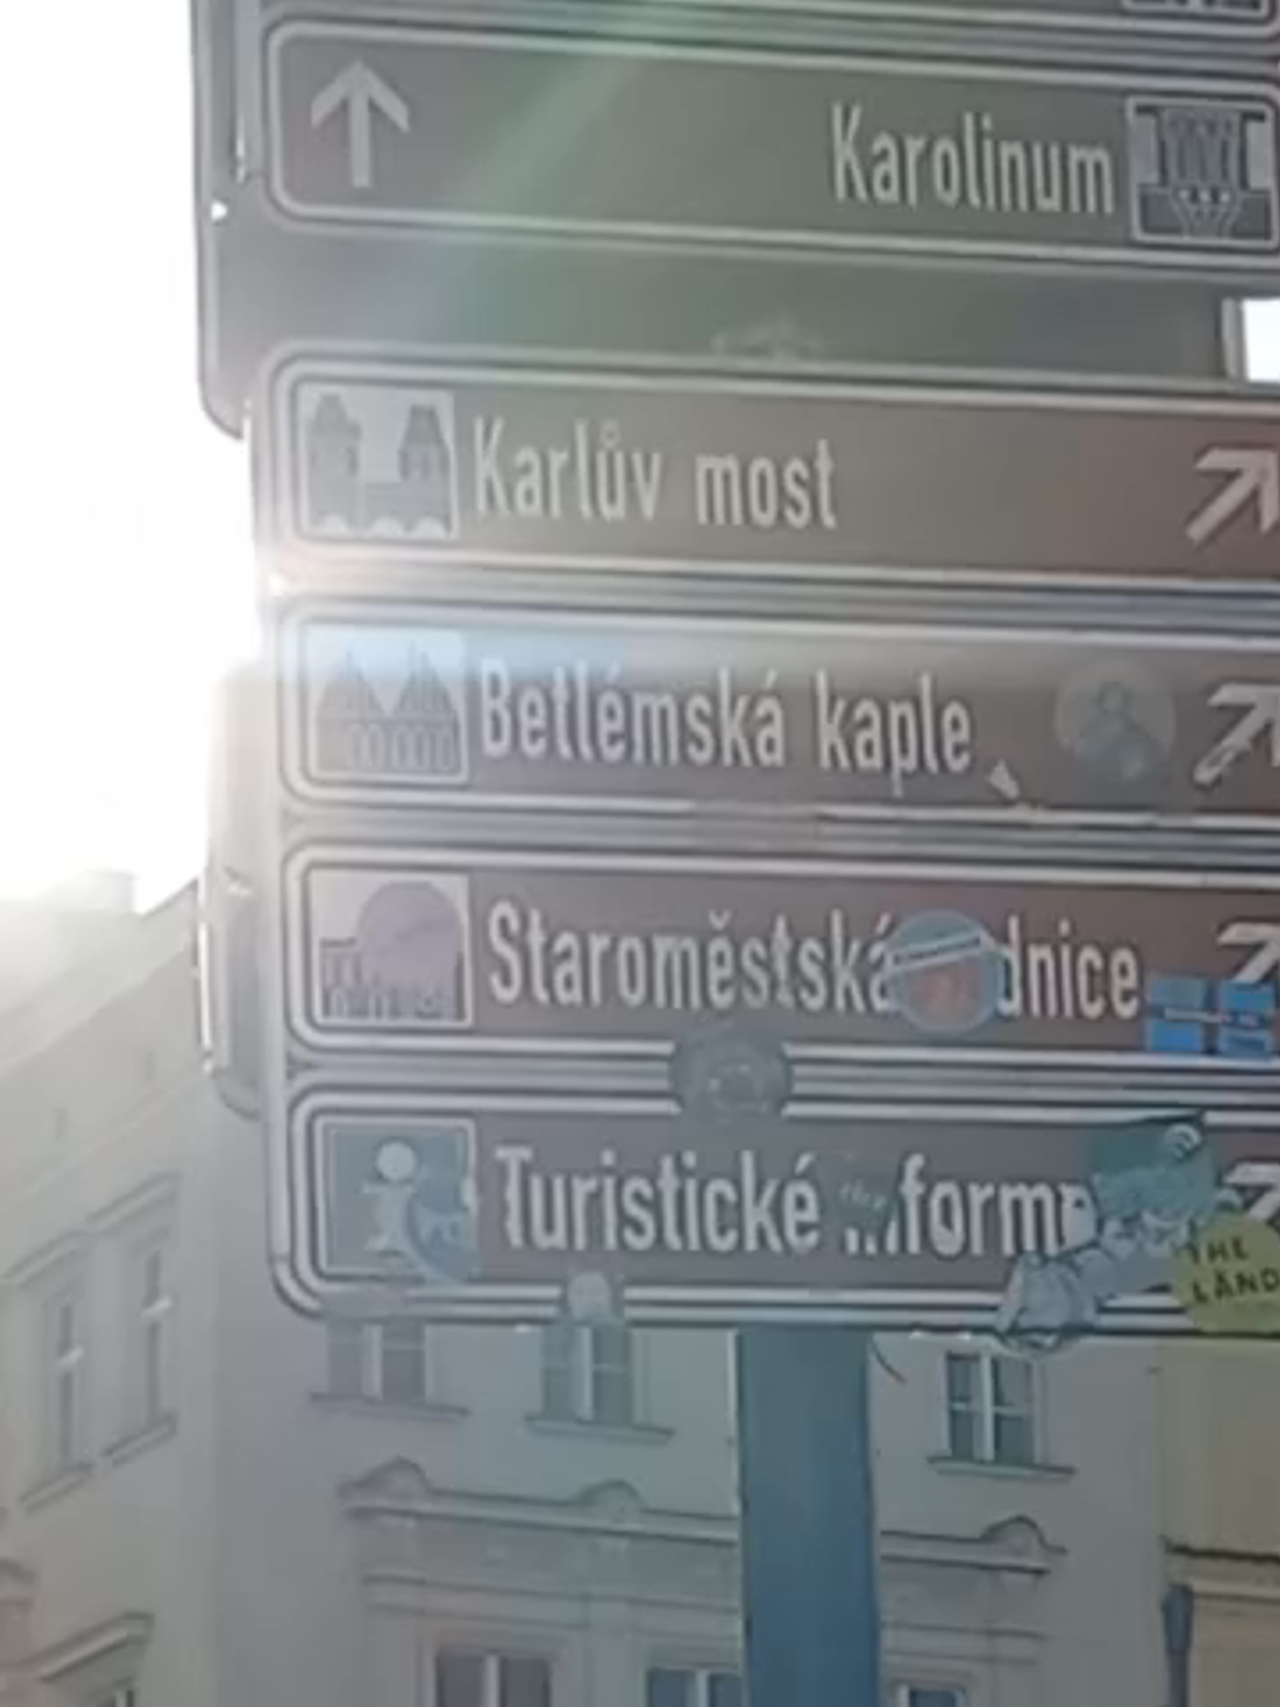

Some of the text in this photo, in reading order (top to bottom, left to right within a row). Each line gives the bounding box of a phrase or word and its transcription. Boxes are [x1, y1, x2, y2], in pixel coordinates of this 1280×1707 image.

[832, 103, 1117, 217] Karolinum
[474, 415, 838, 529] Karlův most
[481, 658, 974, 794] Betlémská kaple
[490, 899, 1140, 1021] Staroměstská dnice
[496, 1143, 1088, 1255] Turistické form
